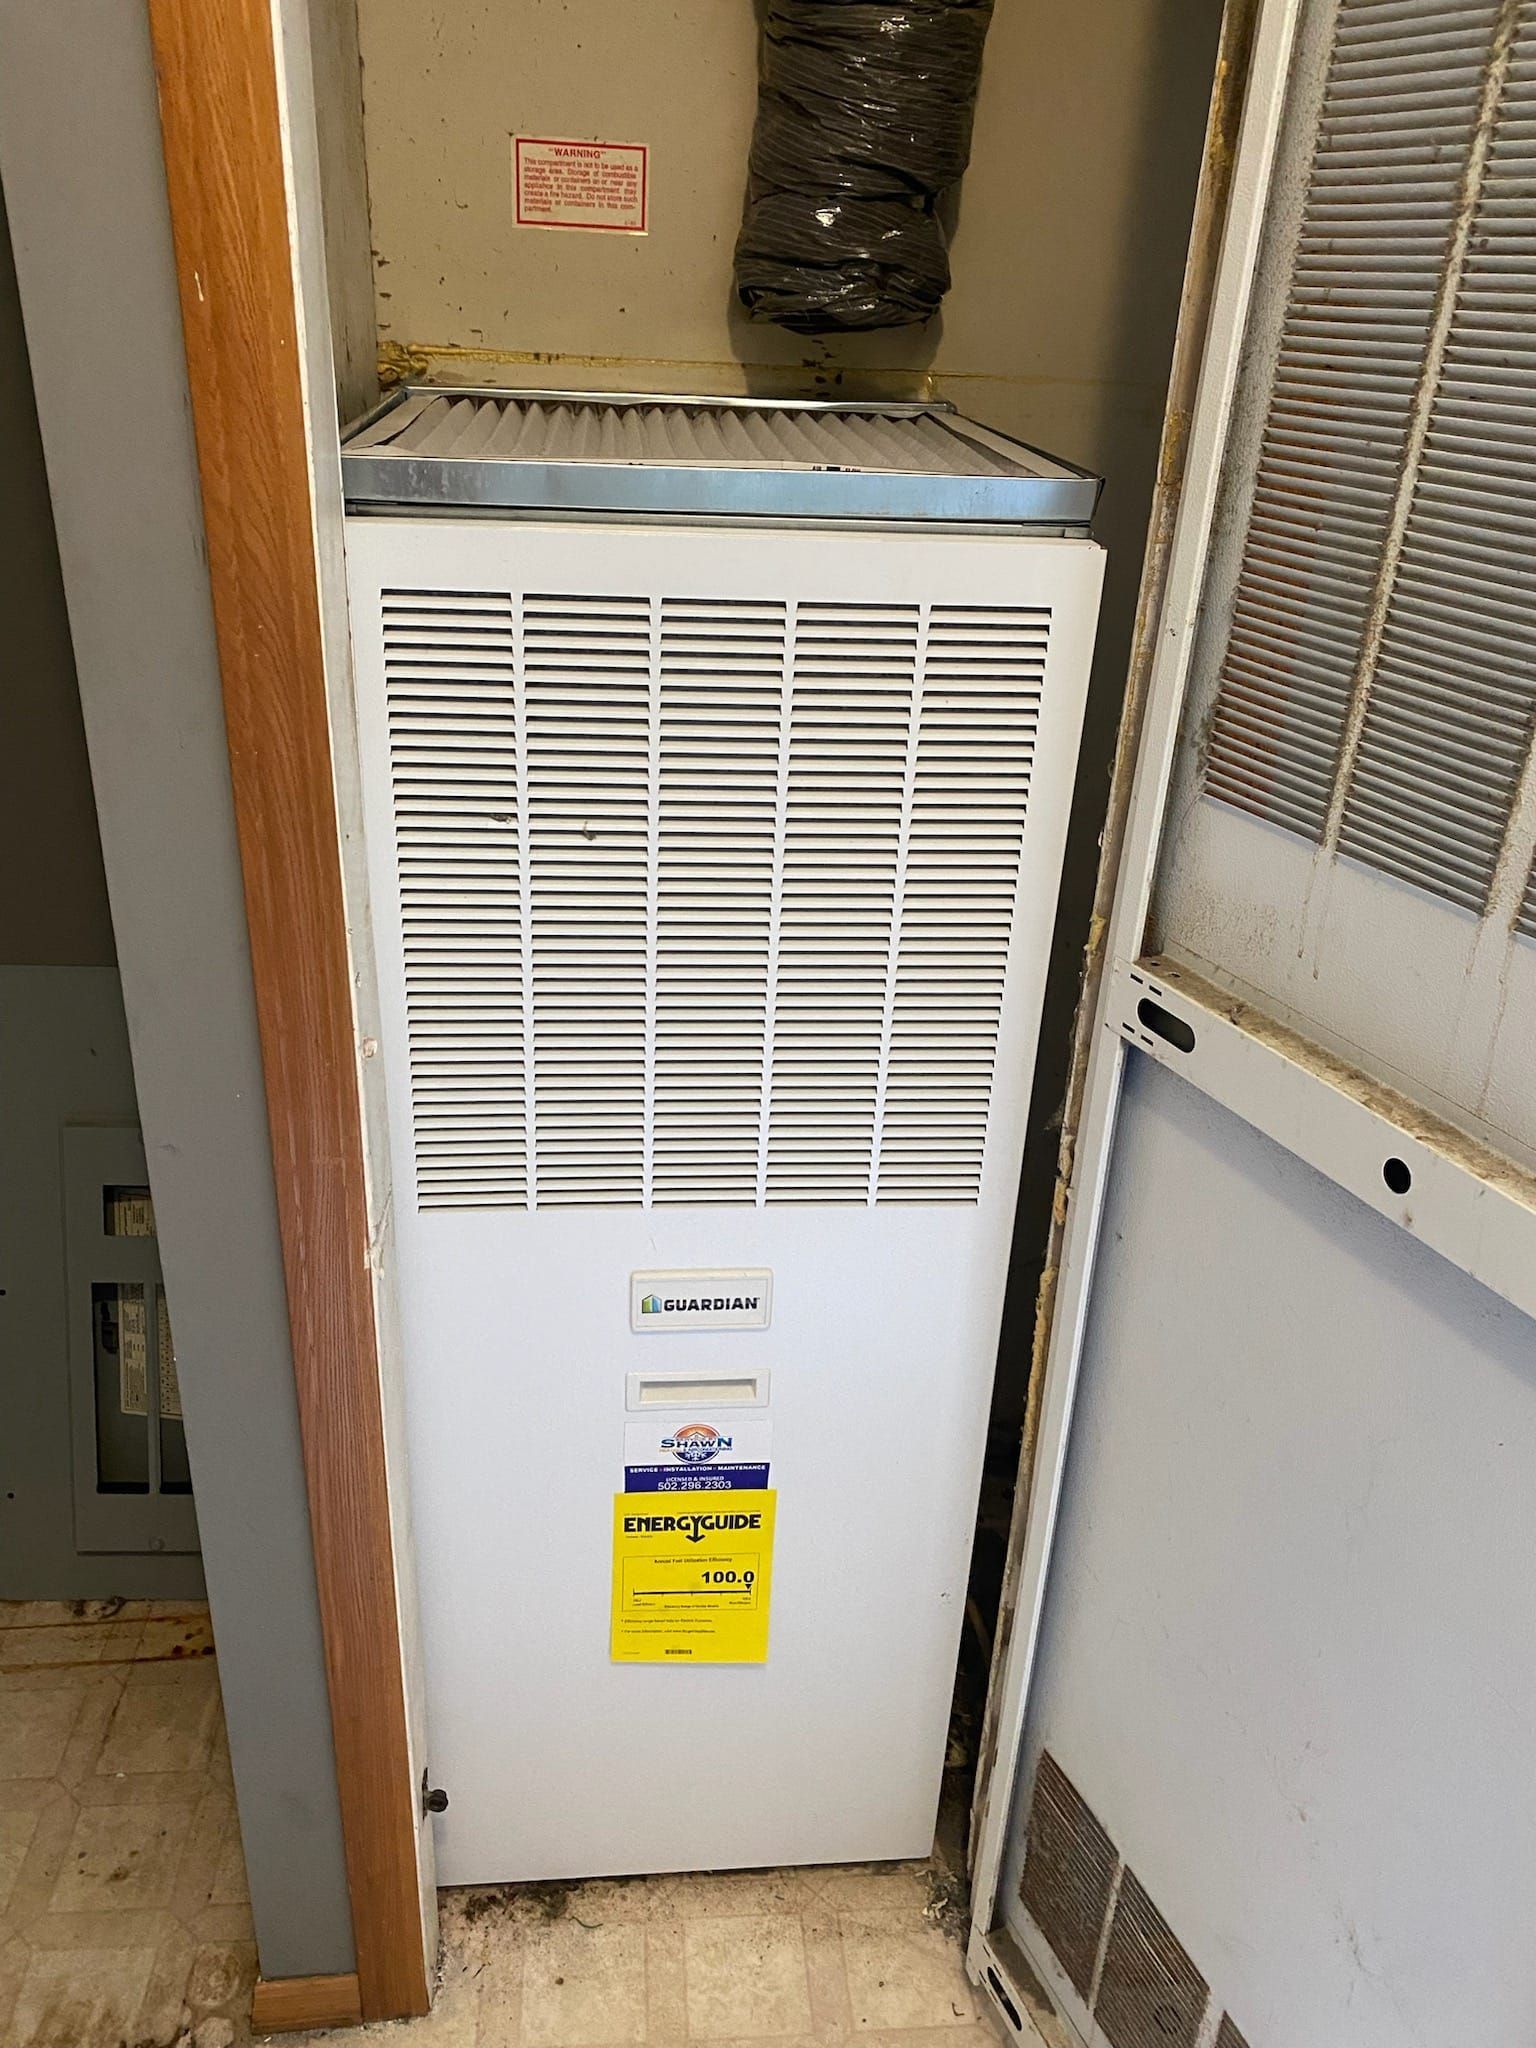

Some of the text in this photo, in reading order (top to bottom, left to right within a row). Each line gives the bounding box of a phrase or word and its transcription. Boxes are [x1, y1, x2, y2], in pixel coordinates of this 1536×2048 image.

[524, 157, 536, 165] This
[538, 160, 575, 168] compartment
[567, 169, 590, 177] Storage
[602, 171, 636, 179] combustible
[561, 176, 590, 184] containers
[581, 186, 619, 194] compartment
[564, 200, 595, 208] containers
[664, 1297, 758, 1311] GUARDIAN
[661, 1437, 733, 1449] SHAWN
[658, 1481, 732, 1491] 502.296.2303
[624, 1514, 761, 1536] ENERGYGUIDE
[701, 1571, 754, 1584] 100.0
